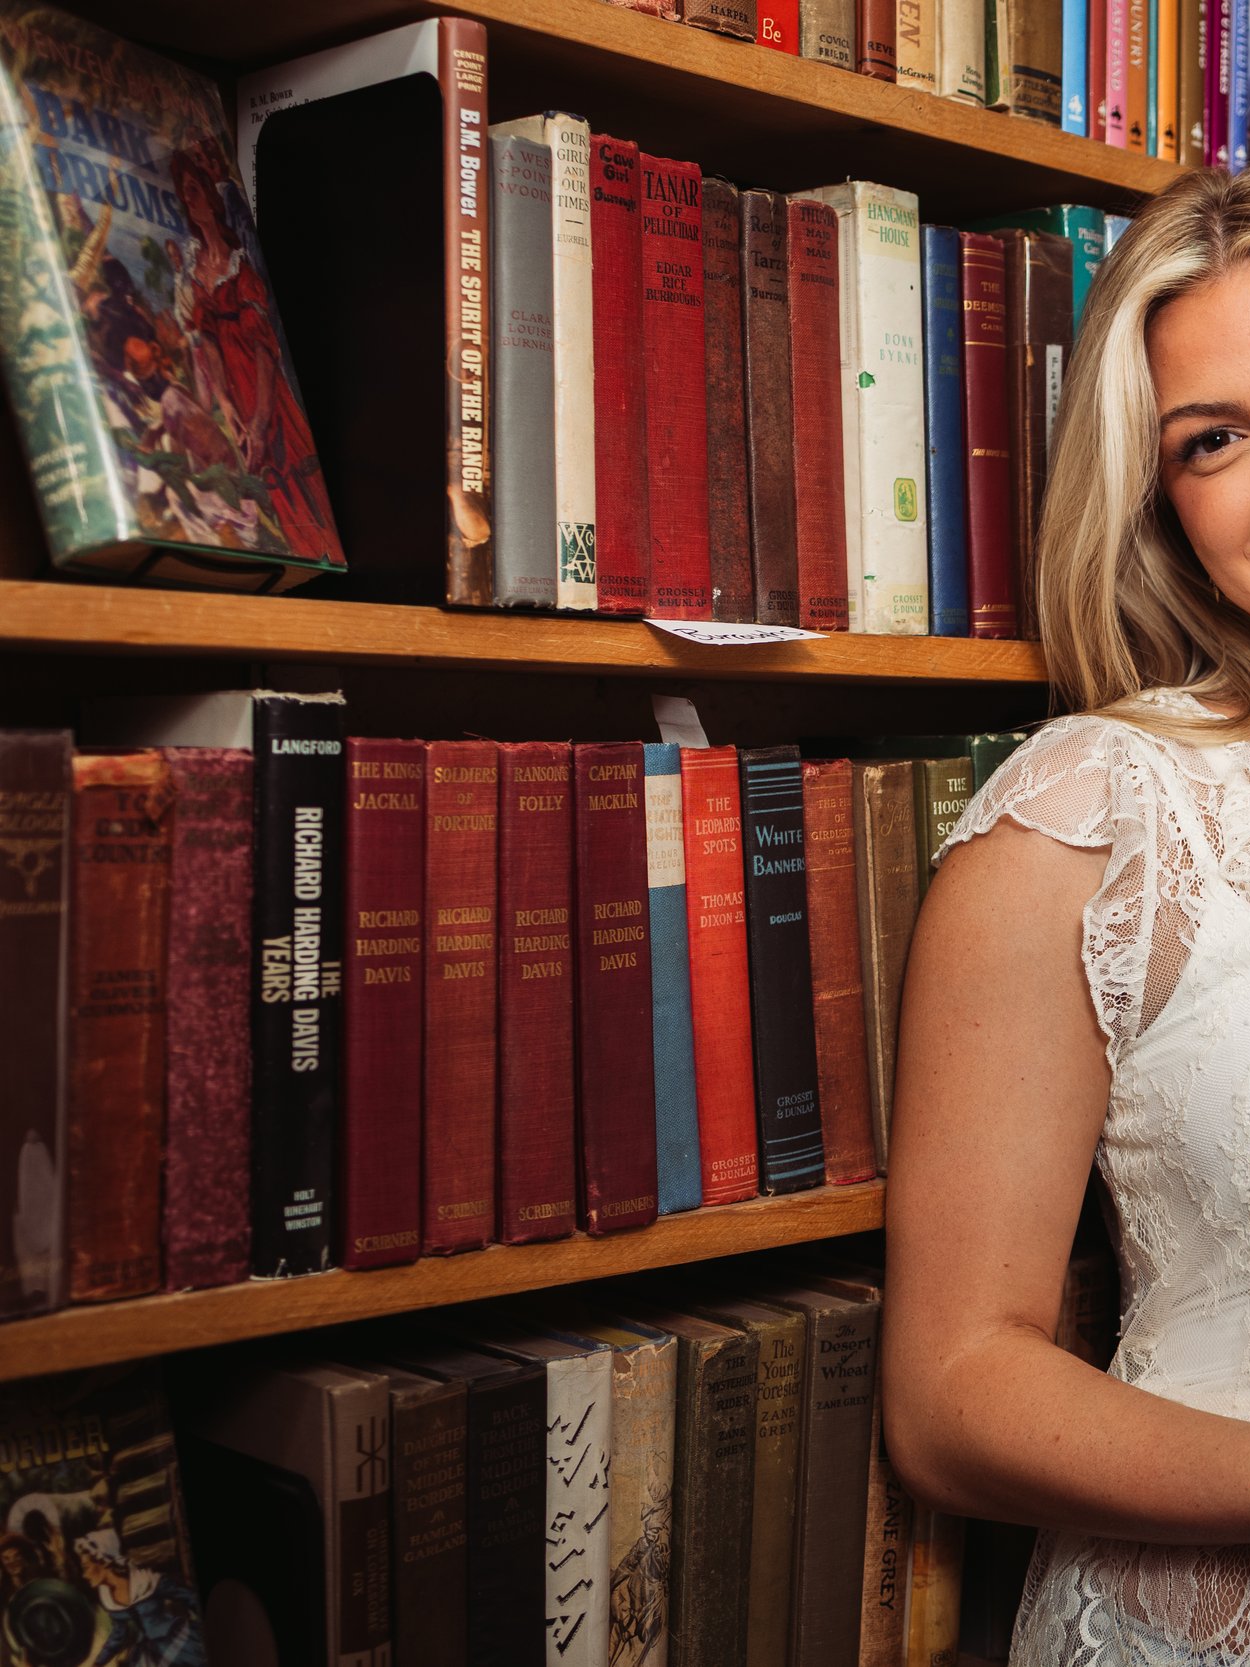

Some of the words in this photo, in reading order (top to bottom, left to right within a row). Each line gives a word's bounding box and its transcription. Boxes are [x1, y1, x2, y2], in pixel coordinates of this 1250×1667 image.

[711, 5, 748, 24] HARPER
[763, 17, 782, 43] Be
[1130, 0, 1144, 70] UNTRY
[1111, 39, 1122, 92] STAND
[561, 131, 586, 146] OUR
[521, 151, 550, 169] WES
[557, 149, 589, 166] GIRLS
[564, 166, 585, 177] AND
[460, 155, 480, 217] Bower
[562, 178, 587, 194] OUR
[643, 170, 699, 208] TANAR
[556, 195, 590, 212] TIMES
[662, 205, 682, 217] OF
[643, 216, 699, 241] PELLUCIDAR
[880, 225, 910, 247] HOUSE
[460, 230, 481, 271] THE
[656, 261, 691, 278] EDGAR
[662, 277, 686, 291] RICE
[981, 281, 1000, 293] THE
[646, 289, 701, 307] BURROUGHS
[461, 276, 481, 345] SPIRIT
[511, 310, 551, 326] CLARA
[508, 323, 552, 339] LOUISE
[885, 333, 913, 349] DONN
[461, 349, 482, 376] OF
[879, 349, 918, 365] BYRNE
[462, 379, 482, 422] THE
[462, 425, 483, 493] RANGE
[600, 575, 648, 588] GROSSET
[658, 588, 706, 598] GROSSET
[893, 594, 923, 604] GROSSET
[271, 739, 342, 755] LANGFORD
[352, 761, 380, 779] THE
[434, 767, 497, 783] SOLDIERS
[588, 764, 637, 781] CAPTAIN
[947, 777, 967, 793] THE
[354, 792, 419, 811] JACKAL
[457, 792, 474, 805] OF
[519, 794, 564, 811] FOLLY
[589, 793, 638, 811] MACKLIN
[706, 797, 732, 812] THE
[818, 799, 837, 809] THE
[433, 814, 496, 832] FORTUNE
[696, 817, 741, 835] LEOPARD'S
[834, 814, 846, 823] OF
[755, 825, 803, 849] WHITE
[294, 807, 324, 901] RICHARD
[703, 838, 737, 855] SPOTS
[753, 854, 805, 877] BANNERS
[702, 891, 743, 909] THOMAS
[438, 907, 491, 925] RICHARD
[516, 908, 568, 926] RICHARD
[594, 900, 642, 919] RICHARD
[770, 911, 802, 926] DOUGLAS
[359, 910, 420, 929] RICHARD
[700, 913, 733, 928] DIXON
[437, 933, 493, 952] HARDING
[514, 934, 569, 953] HARDING
[593, 926, 645, 945] HARDING
[293, 907, 321, 1001] HARDING
[356, 937, 420, 956] HARDING
[261, 935, 292, 1004] YEARS
[444, 961, 485, 979] DAVIS
[522, 961, 562, 979] DAVIS
[600, 953, 637, 971] DAVIS
[364, 966, 411, 984] DAVIS
[292, 1008, 320, 1072] DAVIS
[777, 1090, 814, 1107] GROSSET
[785, 1102, 815, 1118] DUNLAP
[712, 1154, 756, 1171] GROSSET
[294, 1189, 316, 1201] HOLT
[284, 1202, 324, 1217] RINEHART
[601, 1195, 655, 1218] SCRIBNERS
[285, 1216, 321, 1231] WINSTON
[836, 1325, 856, 1338] The
[772, 1339, 794, 1359] The
[820, 1337, 871, 1354] Desert
[726, 1356, 746, 1371] THE
[762, 1359, 800, 1380] Young
[822, 1364, 868, 1380] Wheat
[716, 1394, 751, 1411] RIDER
[816, 1399, 843, 1410] ZANE
[843, 1395, 870, 1408] GREY
[761, 1407, 795, 1422] ZANE
[480, 1418, 542, 1446] TRAILERS
[718, 1426, 746, 1441] ZANE
[759, 1422, 794, 1439] GREY
[714, 1443, 747, 1458] GREY
[414, 1459, 432, 1472] OF
[435, 1448, 460, 1464] THE
[480, 1453, 540, 1480] MIDDLE
[406, 1463, 465, 1492] MIDDLE
[480, 1470, 539, 1499] BORDER
[407, 1483, 464, 1512] BORDER
[884, 1482, 901, 1542] ZANE
[410, 1520, 463, 1546] HAMLIN
[403, 1534, 467, 1563] GARLAND
[879, 1549, 897, 1611] GREY
